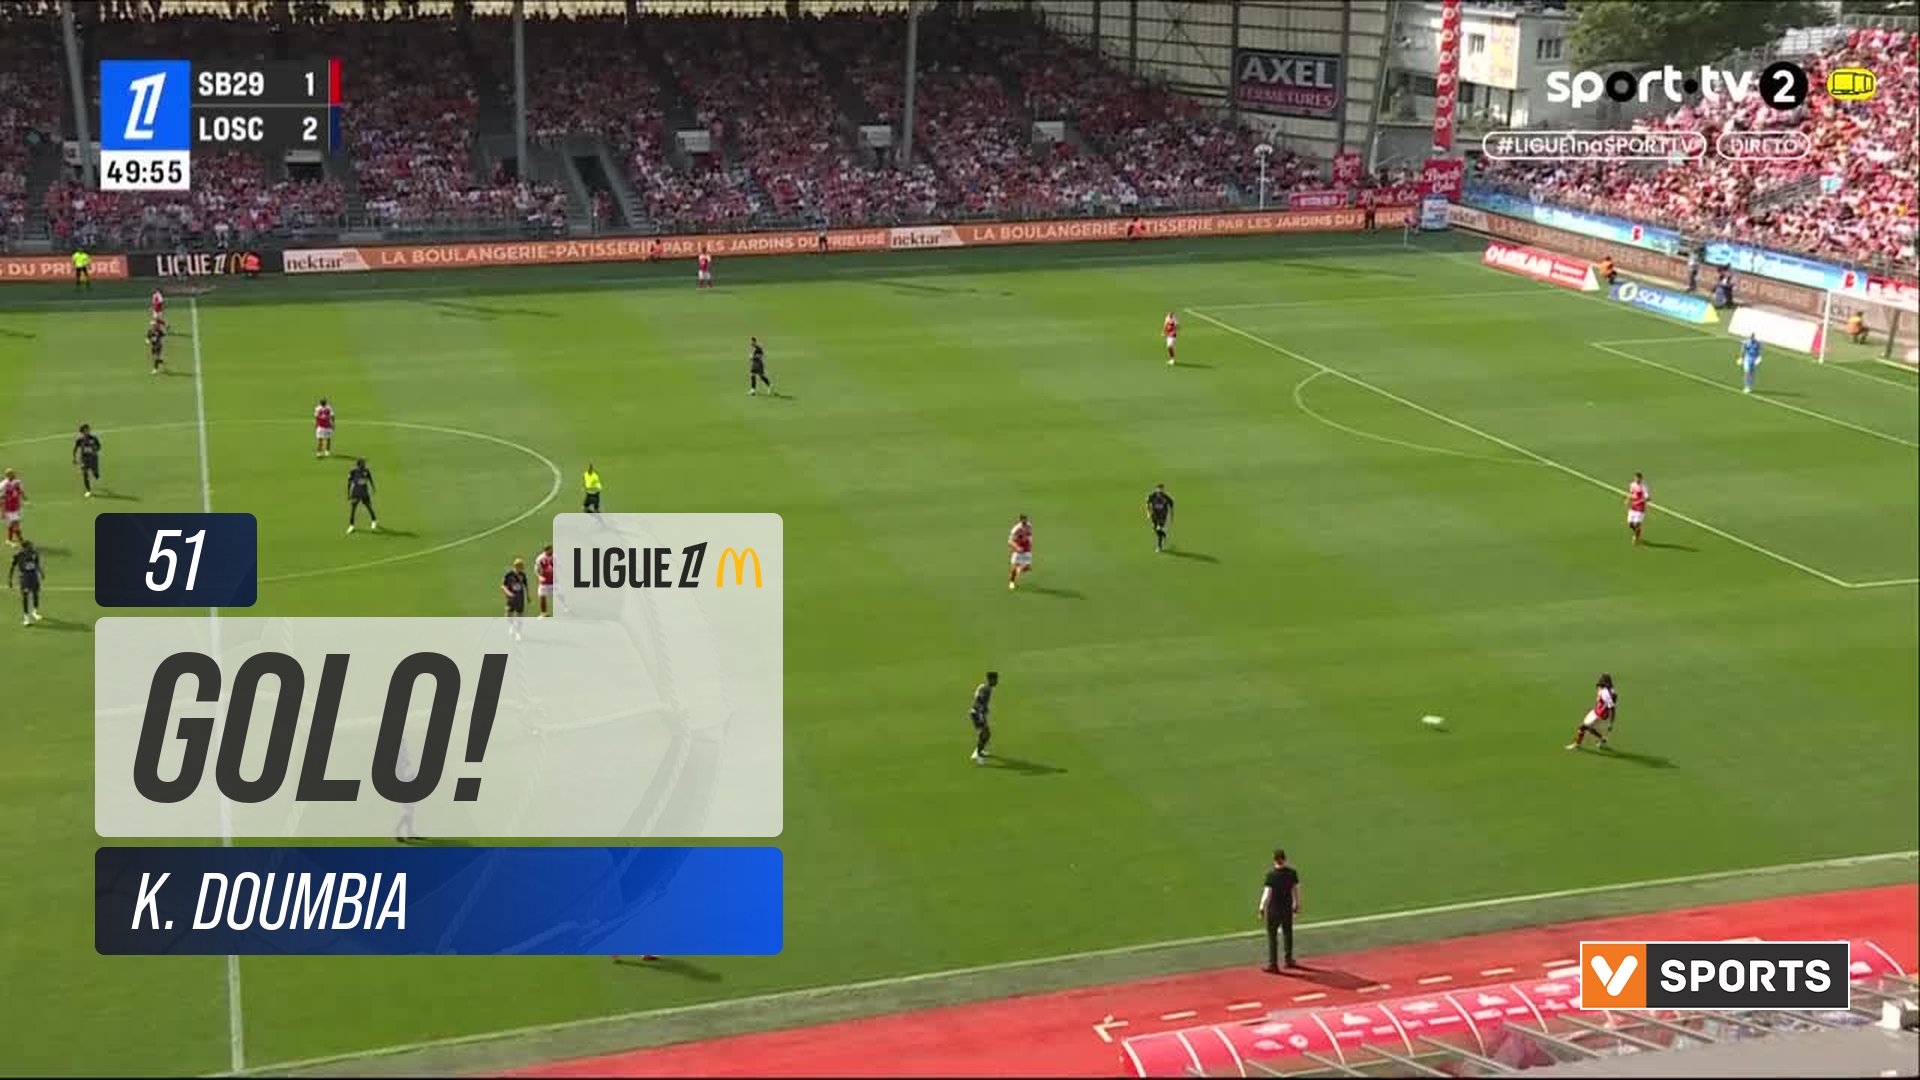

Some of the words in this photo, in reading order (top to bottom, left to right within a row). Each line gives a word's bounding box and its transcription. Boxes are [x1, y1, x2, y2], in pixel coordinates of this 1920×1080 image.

[1240, 57, 1333, 88] AXEL
[973, 228, 996, 241] LA
[1217, 217, 1244, 230] PAR
[1248, 214, 1274, 228] LES
[1275, 212, 1335, 228] JARDINS
[1336, 212, 1355, 225] DU
[892, 231, 940, 247] nektar
[381, 250, 407, 265] LA
[662, 241, 694, 254] PAR
[697, 239, 727, 253] LES
[728, 236, 795, 251] JARDINS
[8, 262, 36, 276] DU
[286, 255, 345, 270] nektar
